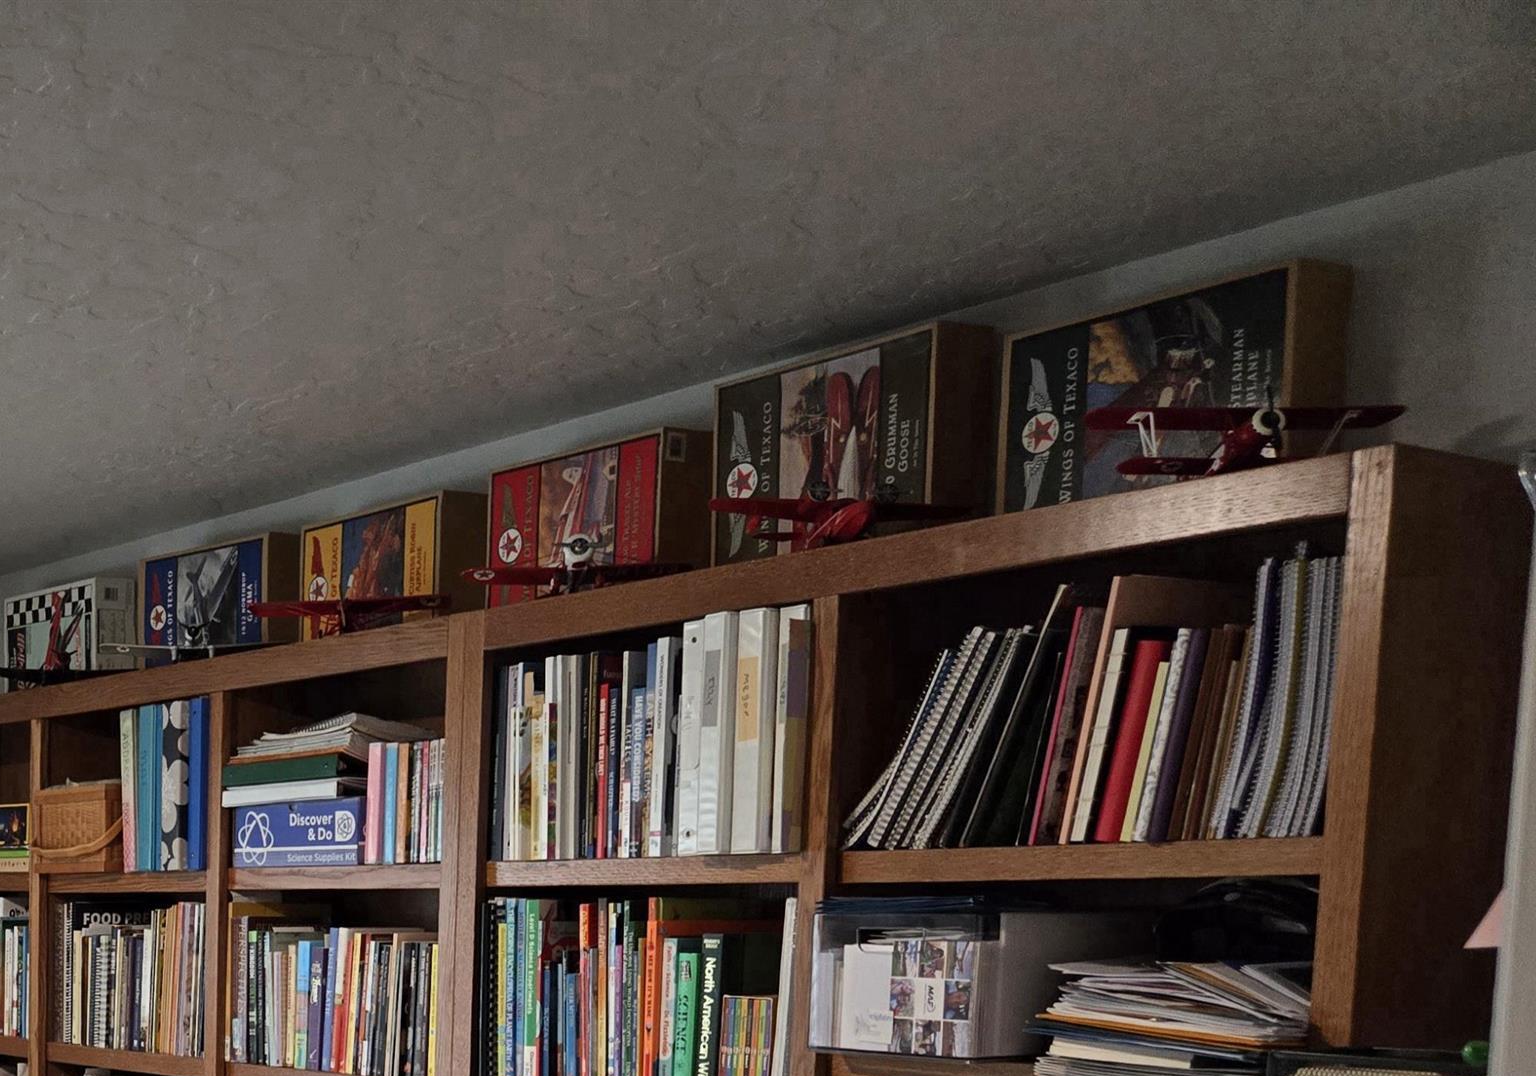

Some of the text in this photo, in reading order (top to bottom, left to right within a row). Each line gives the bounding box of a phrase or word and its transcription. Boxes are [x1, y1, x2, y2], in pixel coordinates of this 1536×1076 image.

[884, 393, 898, 469] GRUMMAN
[1060, 348, 1078, 503] WINGS OF TEXACO
[760, 401, 771, 492] OF TEXACO
[897, 420, 910, 472] GOOSE
[330, 537, 339, 597] OF TEXACO
[167, 613, 174, 625] OF
[634, 720, 643, 742] YOU
[288, 812, 334, 827] Discover
[307, 827, 333, 841] & Do
[287, 851, 357, 865] Science Supplies Kit
[83, 913, 121, 926] FOOD
[528, 914, 536, 932] Level
[237, 924, 247, 1014] PERSPECTIVES
[527, 942, 535, 966] Science
[506, 958, 514, 1002] ENCYCLOPEDIA
[526, 967, 534, 1015] Experiments
[704, 957, 717, 993] North
[506, 1003, 513, 1013] OF
[675, 994, 690, 1056] SCIENCE
[698, 995, 715, 1060] American
